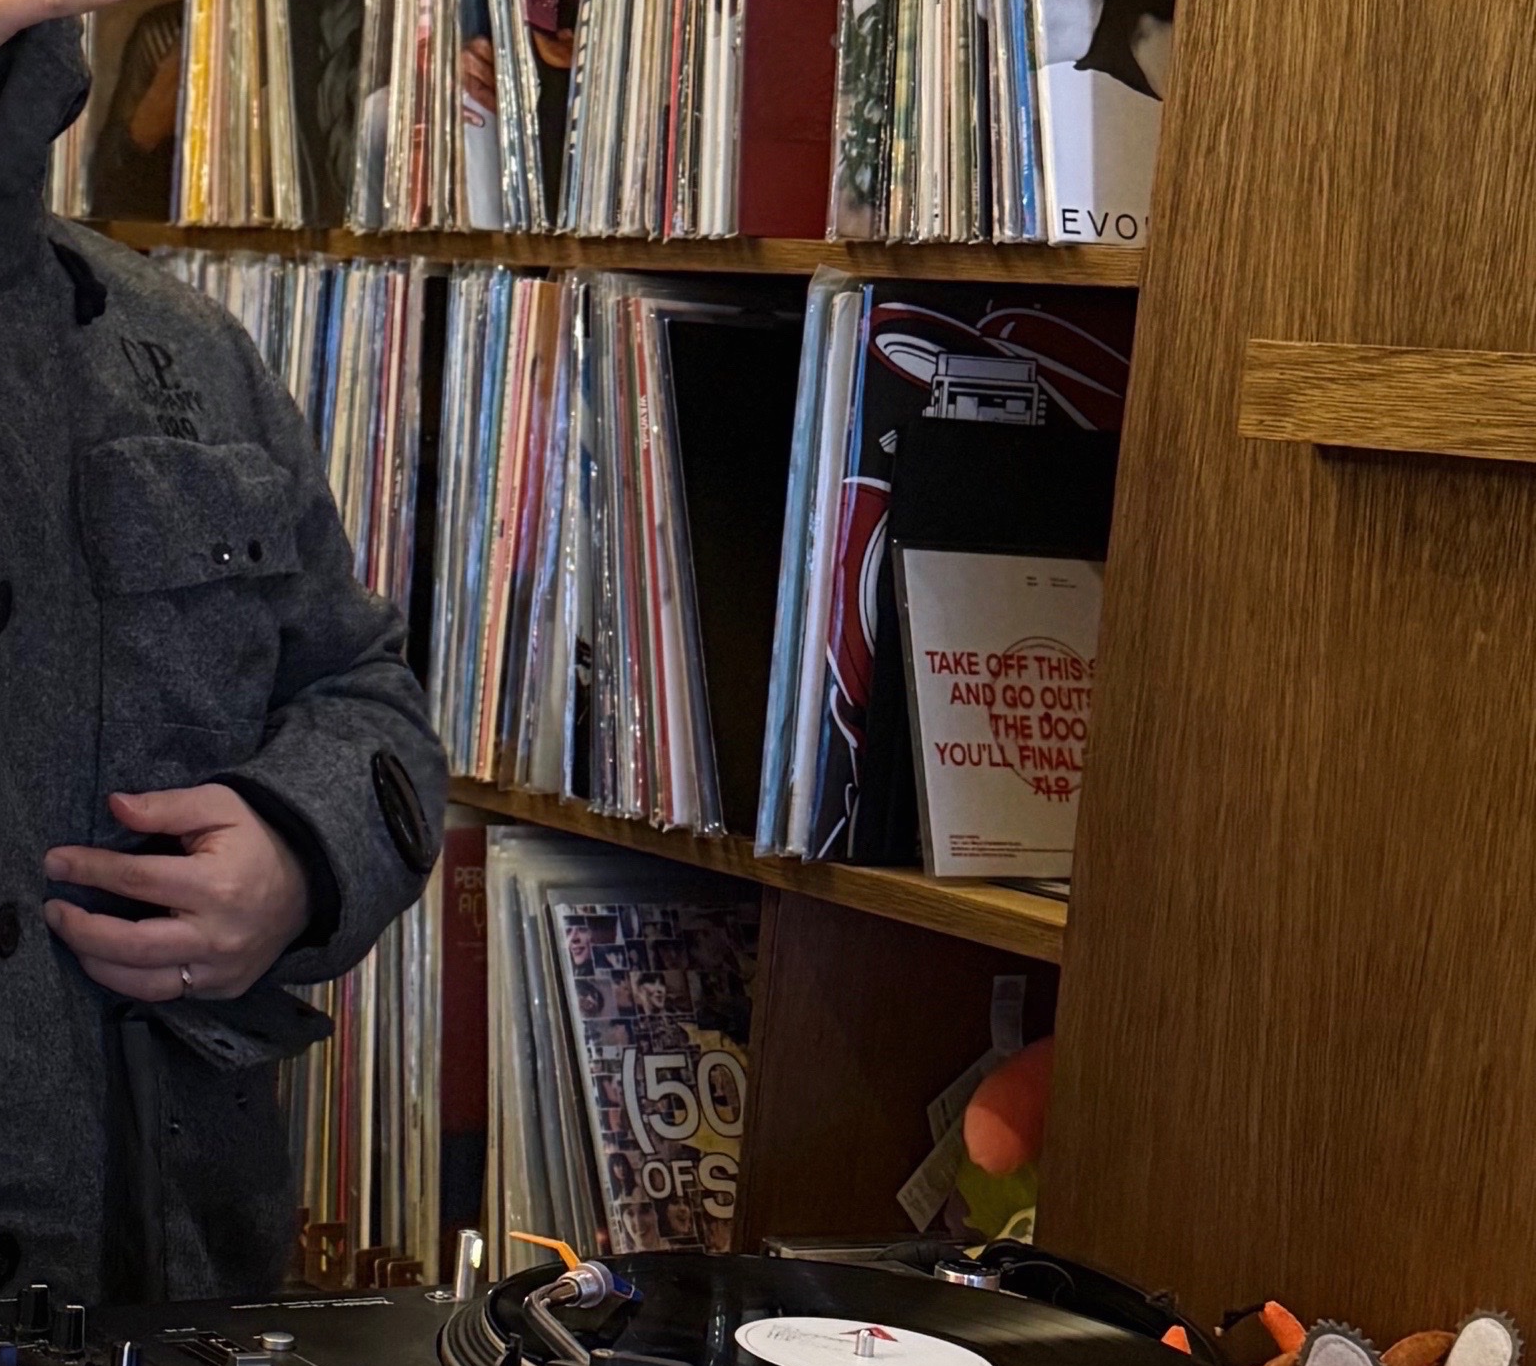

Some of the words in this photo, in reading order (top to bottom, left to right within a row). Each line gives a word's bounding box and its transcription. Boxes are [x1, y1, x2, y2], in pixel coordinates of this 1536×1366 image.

[925, 651, 980, 677] TAKE
[985, 653, 1029, 679] OFF
[1033, 656, 1083, 681] THIS
[950, 682, 996, 707] AND
[1002, 684, 1035, 710] GO
[989, 713, 1034, 740] THE
[934, 742, 1014, 768] YOU'LL
[641, 1158, 694, 1200] OF
